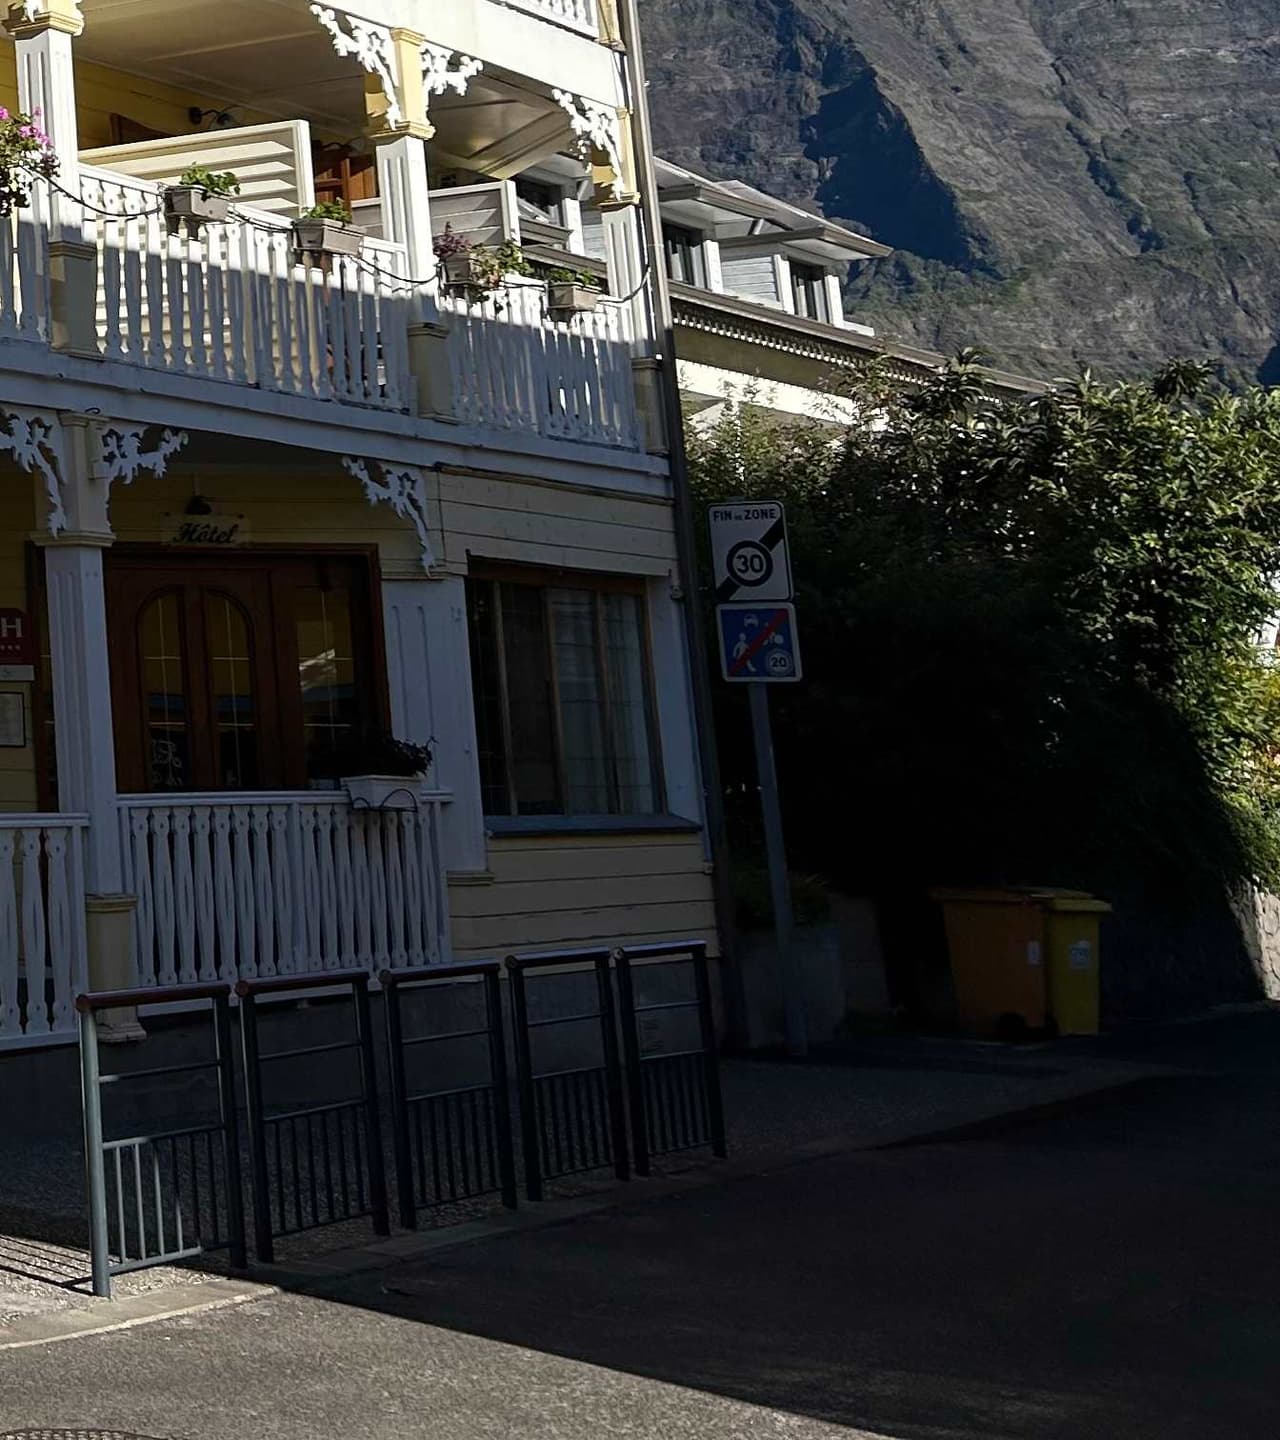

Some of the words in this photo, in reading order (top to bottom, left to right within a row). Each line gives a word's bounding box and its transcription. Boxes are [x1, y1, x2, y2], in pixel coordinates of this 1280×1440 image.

[713, 510, 732, 521] FIN
[744, 508, 777, 520] ZONE
[172, 522, 239, 544] Hôtel
[736, 554, 764, 573] 30
[0, 616, 23, 639] H
[771, 656, 786, 667] 20
